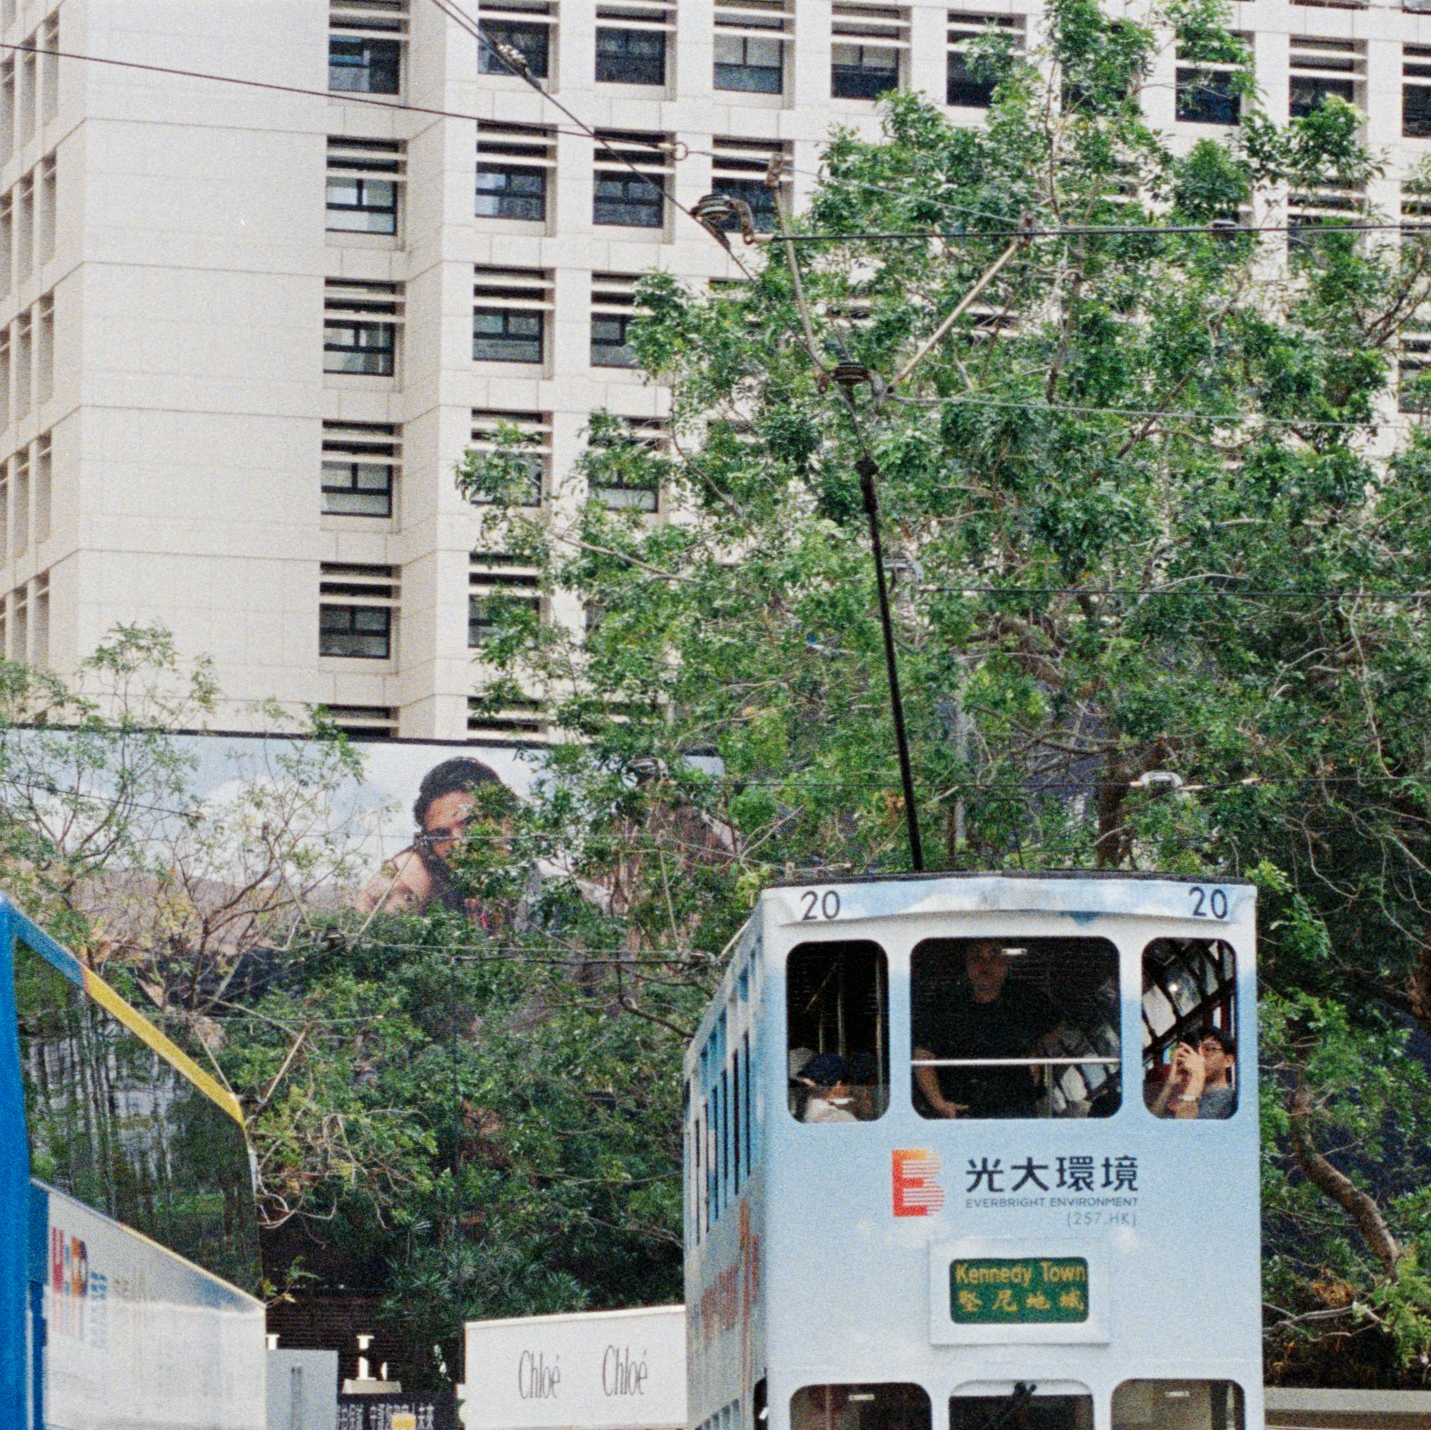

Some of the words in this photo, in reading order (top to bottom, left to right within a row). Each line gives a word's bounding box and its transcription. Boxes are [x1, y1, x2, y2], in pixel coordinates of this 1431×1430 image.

[801, 890, 840, 920] 20
[1189, 886, 1229, 919] 20
[966, 1155, 1138, 1193] 光大環境
[966, 1198, 1045, 1208] EVERBRIGHT
[1050, 1197, 1138, 1207] ENVIRONMENT
[955, 1264, 1032, 1287] Kennedy
[1041, 1261, 1086, 1282] Town
[519, 1350, 560, 1399] Chloé
[602, 1344, 648, 1397] Chloé
